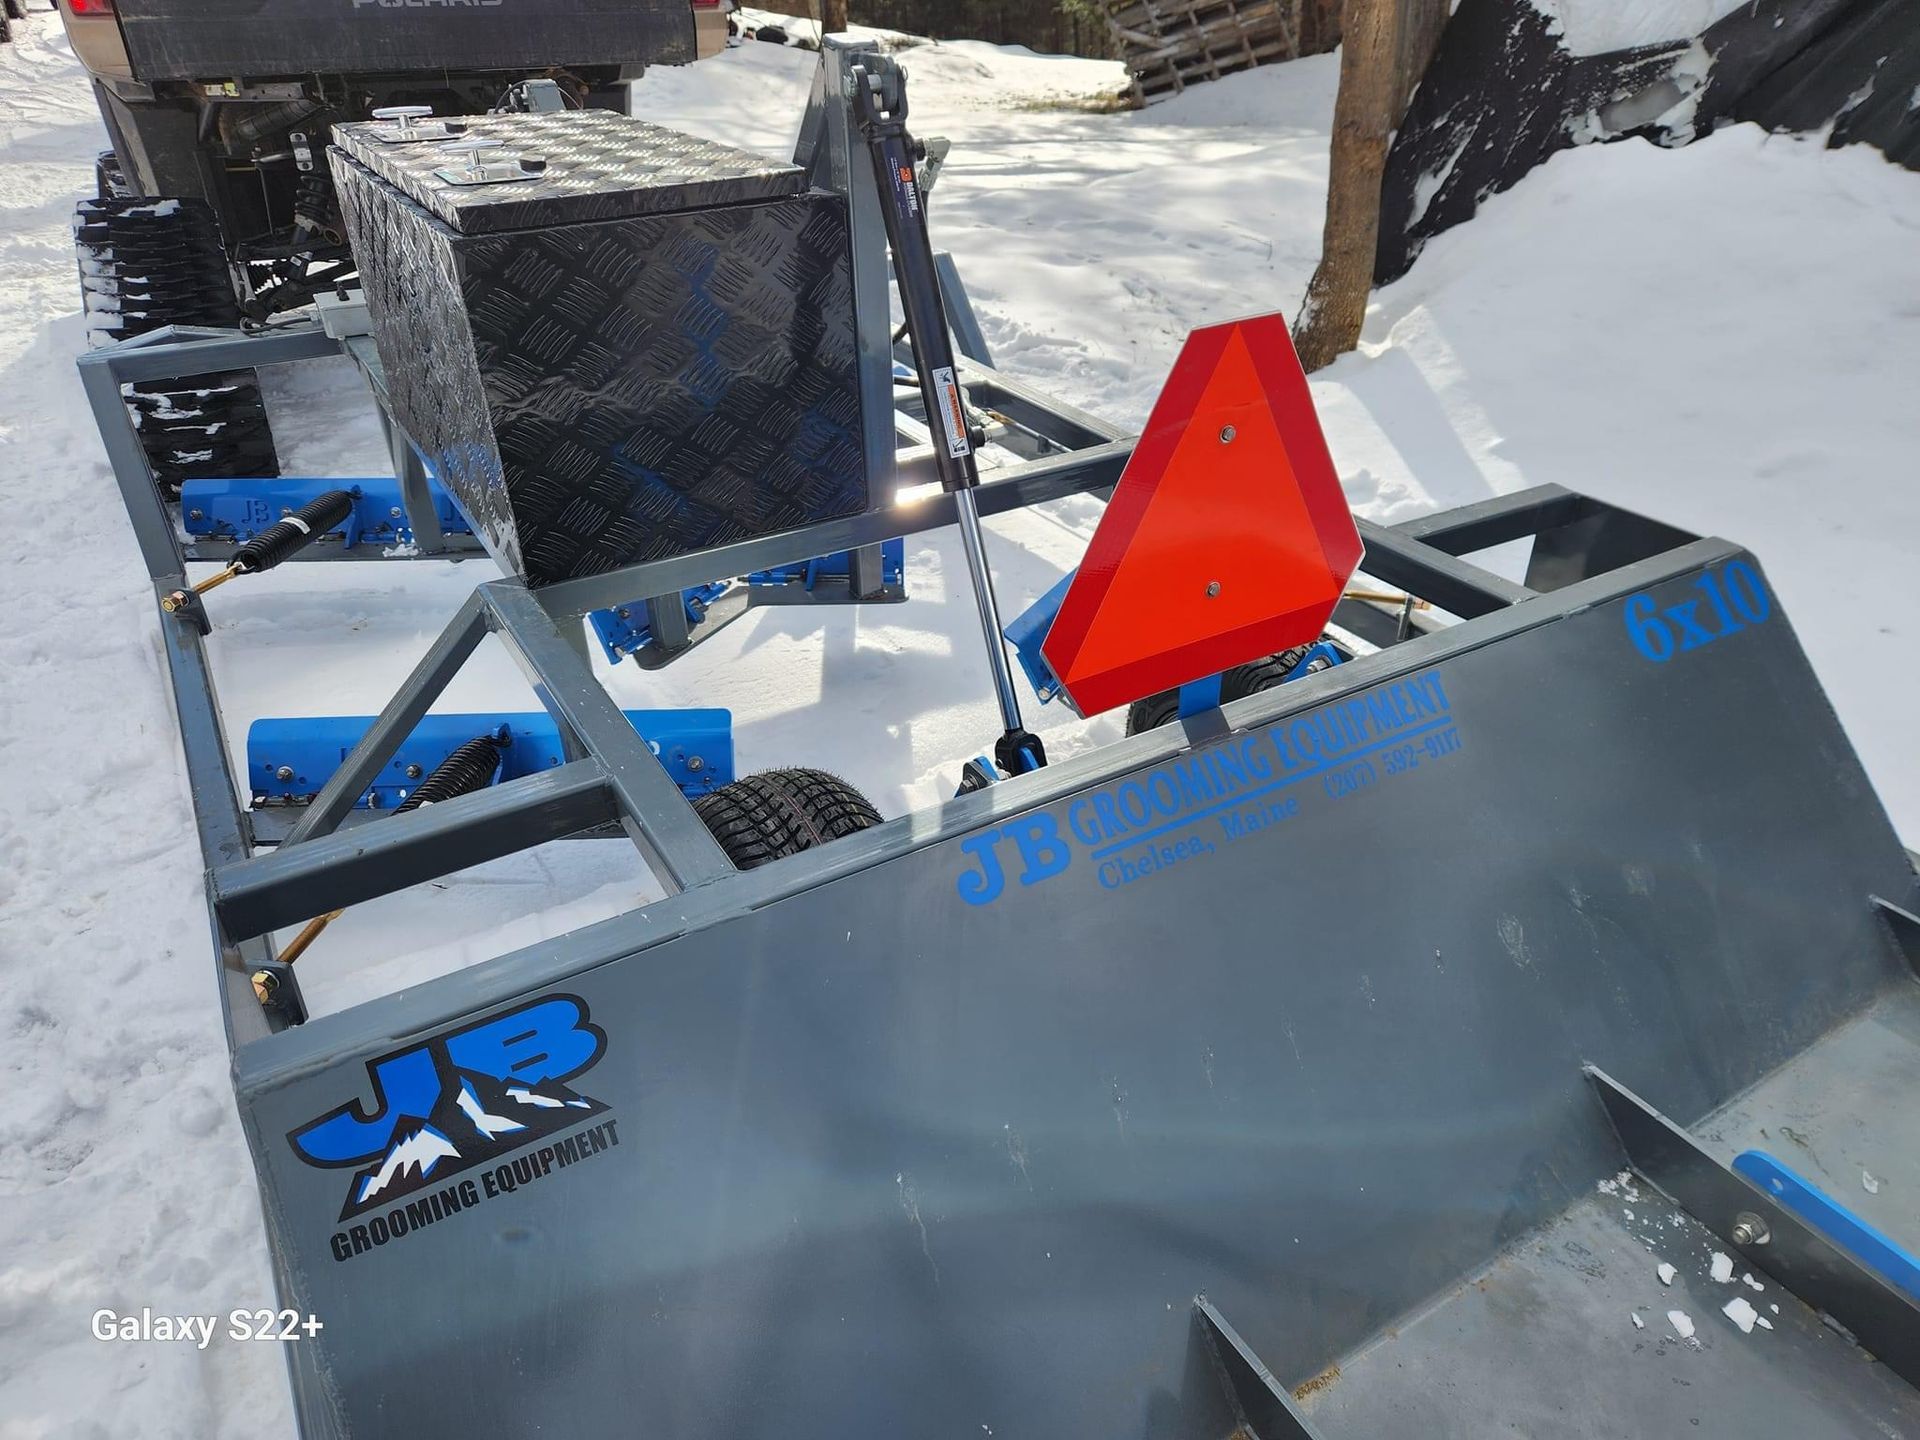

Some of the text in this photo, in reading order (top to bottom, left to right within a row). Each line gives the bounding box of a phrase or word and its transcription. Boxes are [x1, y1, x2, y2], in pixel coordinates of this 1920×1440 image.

[1623, 560, 1770, 662] 6x10
[957, 671, 1451, 906] JB GROOMING EQUIPMENT
[1098, 832, 1215, 890] Chelsea,
[1219, 795, 1297, 844] Maine
[1323, 760, 1376, 801] (207)
[286, 993, 607, 1168] JB
[329, 1118, 621, 1262] GROOMING EQUIPMENT
